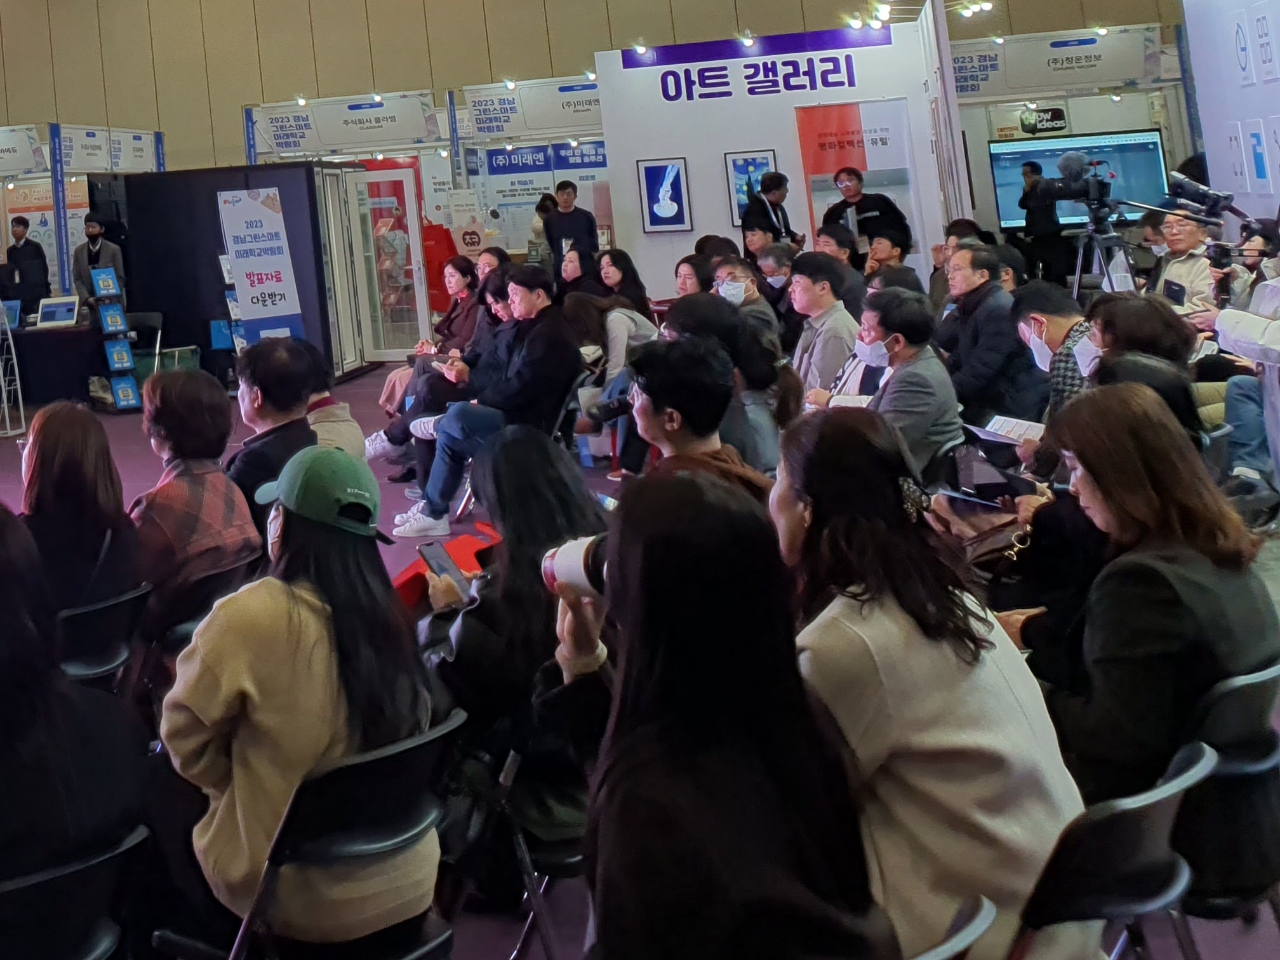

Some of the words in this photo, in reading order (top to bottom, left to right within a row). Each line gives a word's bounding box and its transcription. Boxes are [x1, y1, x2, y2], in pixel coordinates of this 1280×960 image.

[951, 55, 975, 65] 023
[977, 53, 999, 63] 경남
[660, 65, 734, 103] 아트
[743, 53, 857, 97] 갤러리
[471, 99, 495, 108] 2023
[498, 97, 516, 106] 경남
[473, 106, 518, 117] 그린스마트
[269, 115, 291, 125] 2023
[293, 113, 310, 123] 경남
[342, 116, 372, 127] 주식회사
[475, 115, 511, 125] 미래학교
[1036, 119, 1066, 130] ideas
[271, 122, 313, 133] 그린스마트
[477, 124, 505, 133] 박람회
[273, 131, 307, 140] 미래학교
[275, 139, 301, 149] 박람회
[492, 155, 509, 167] (주)
[511, 152, 545, 166] 미래엔
[244, 219, 264, 230] 2023
[232, 231, 282, 245] 경남그린스마트
[234, 245, 285, 259] 미래학교박람회
[245, 270, 284, 288] 발표자료
[250, 291, 287, 307] 다운받기
